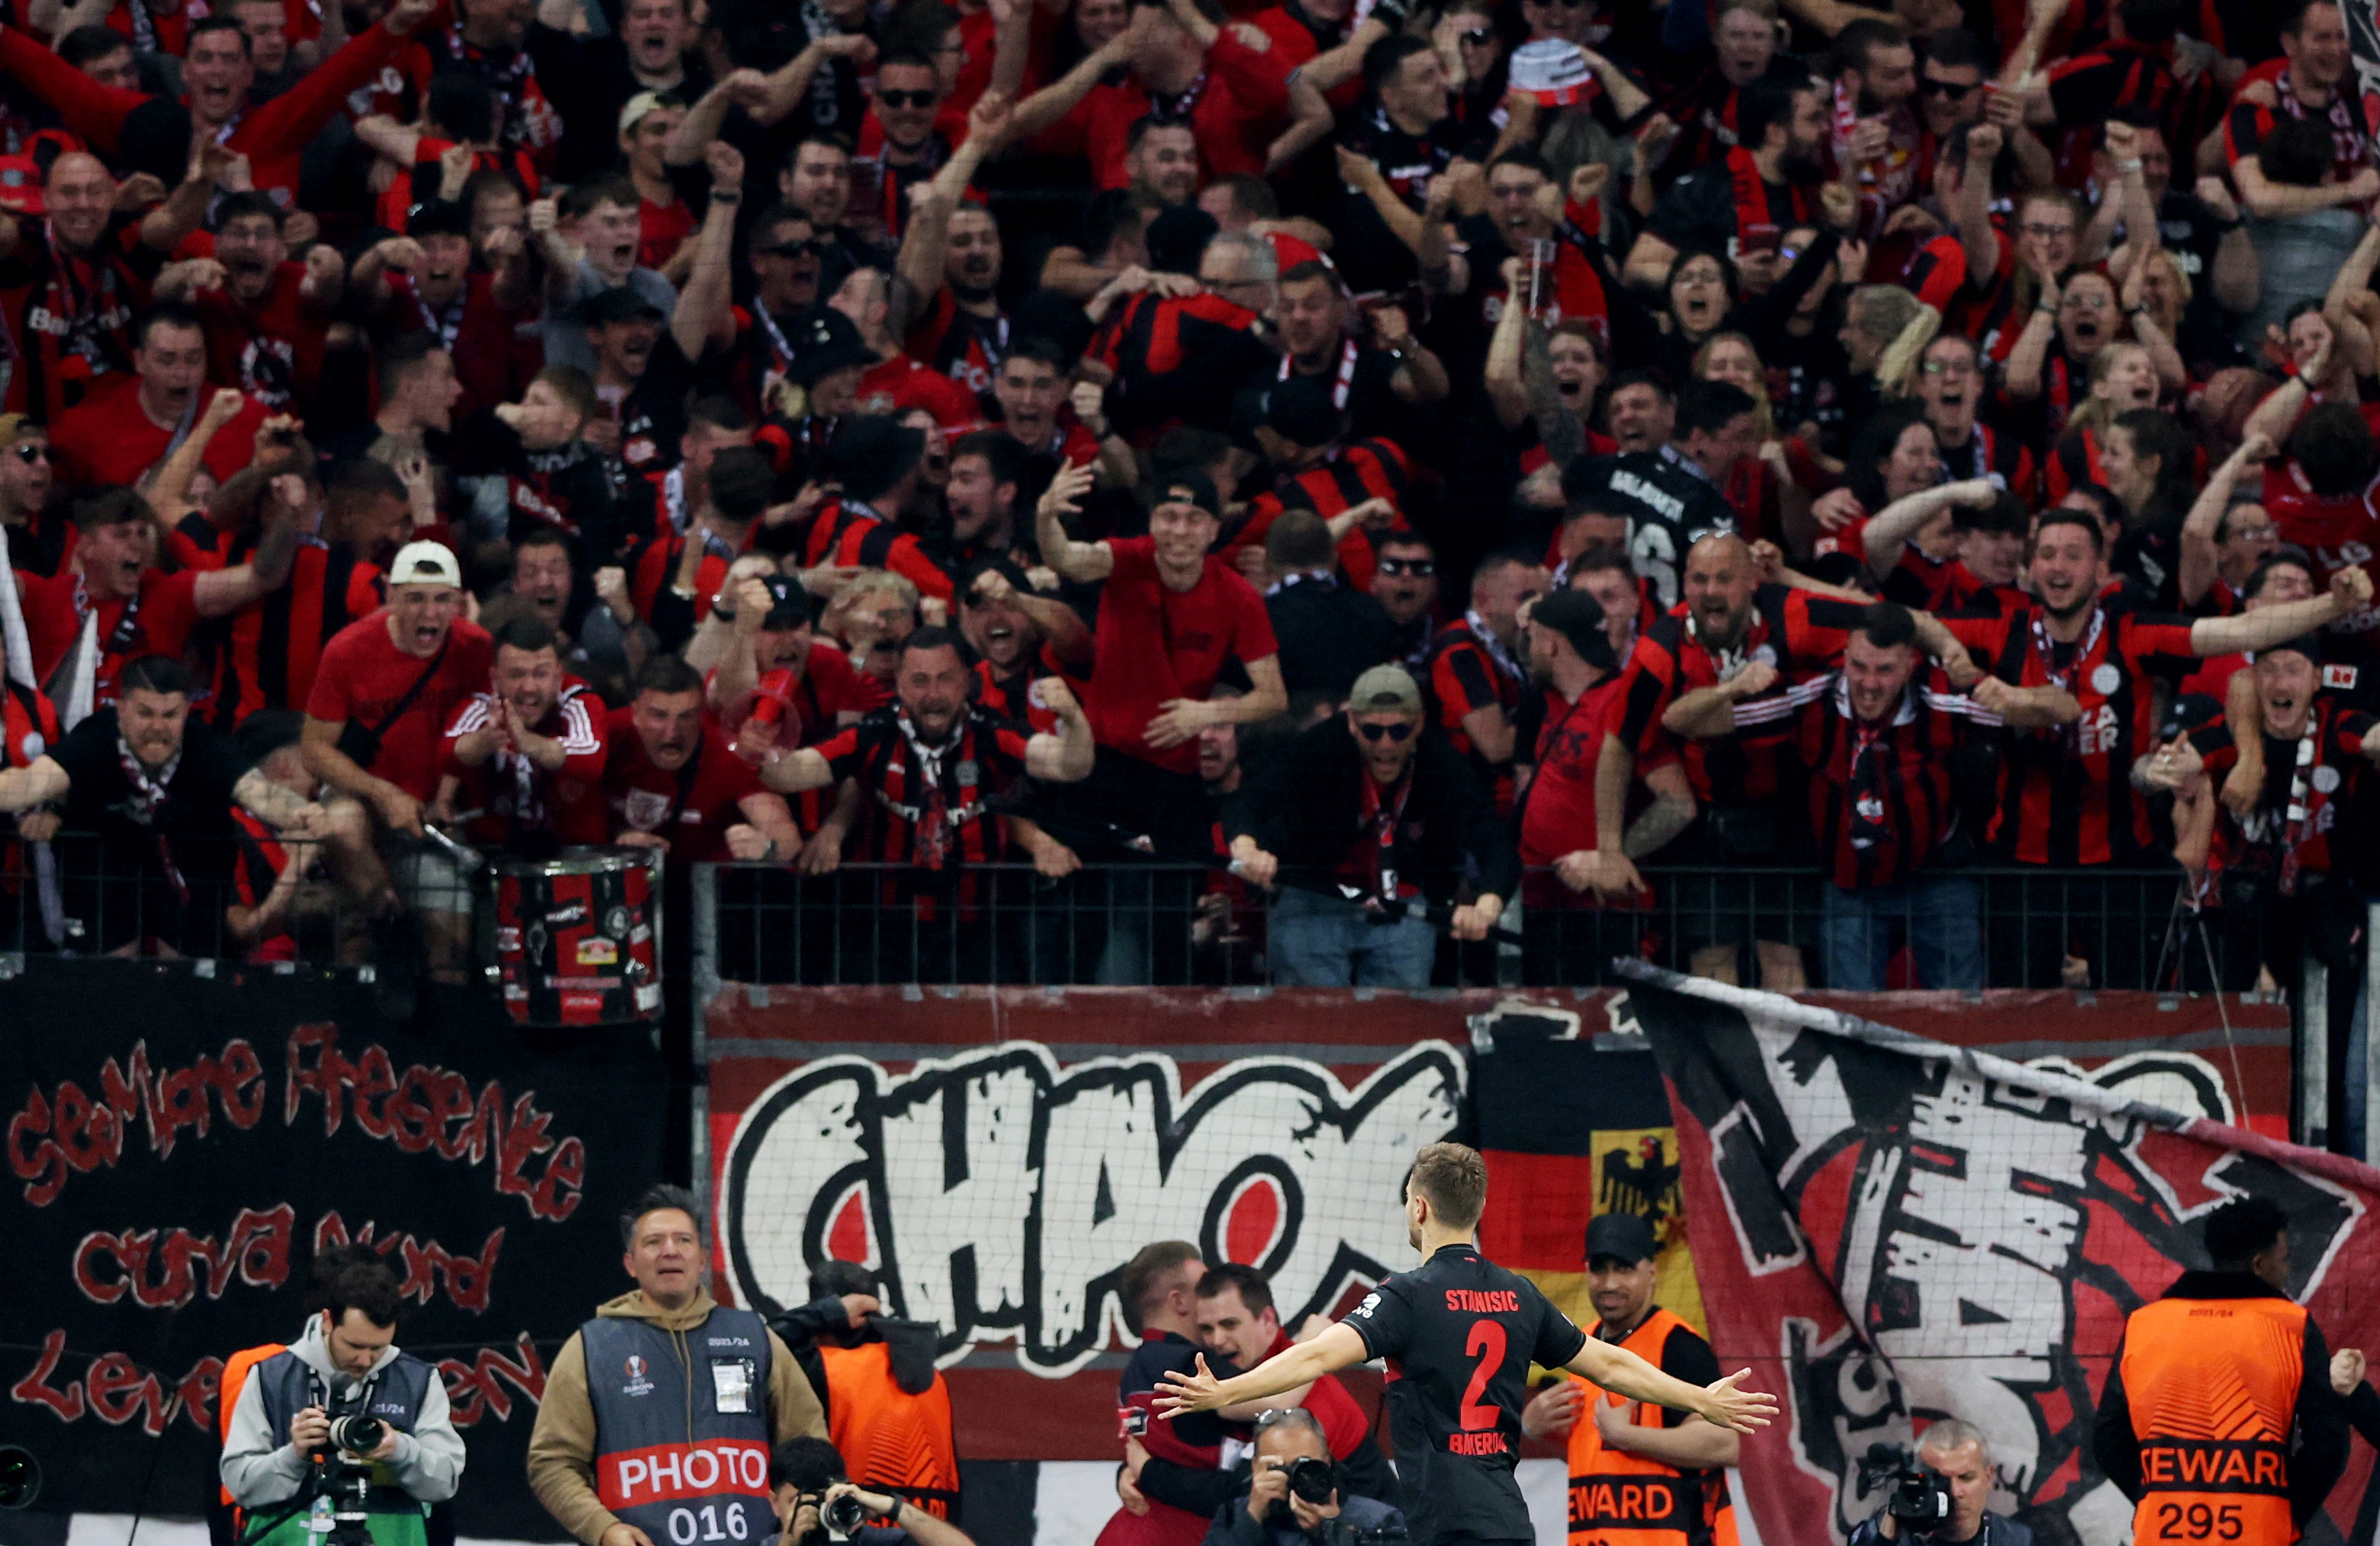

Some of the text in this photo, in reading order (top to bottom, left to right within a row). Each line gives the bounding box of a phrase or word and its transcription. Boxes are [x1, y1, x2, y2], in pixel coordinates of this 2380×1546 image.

[1445, 1289, 1520, 1313] STANISIC
[1460, 1319, 1507, 1431] 2
[619, 1446, 767, 1499] PHOTO
[668, 1502, 748, 1545] 016
[2157, 1502, 2243, 1540] 295
